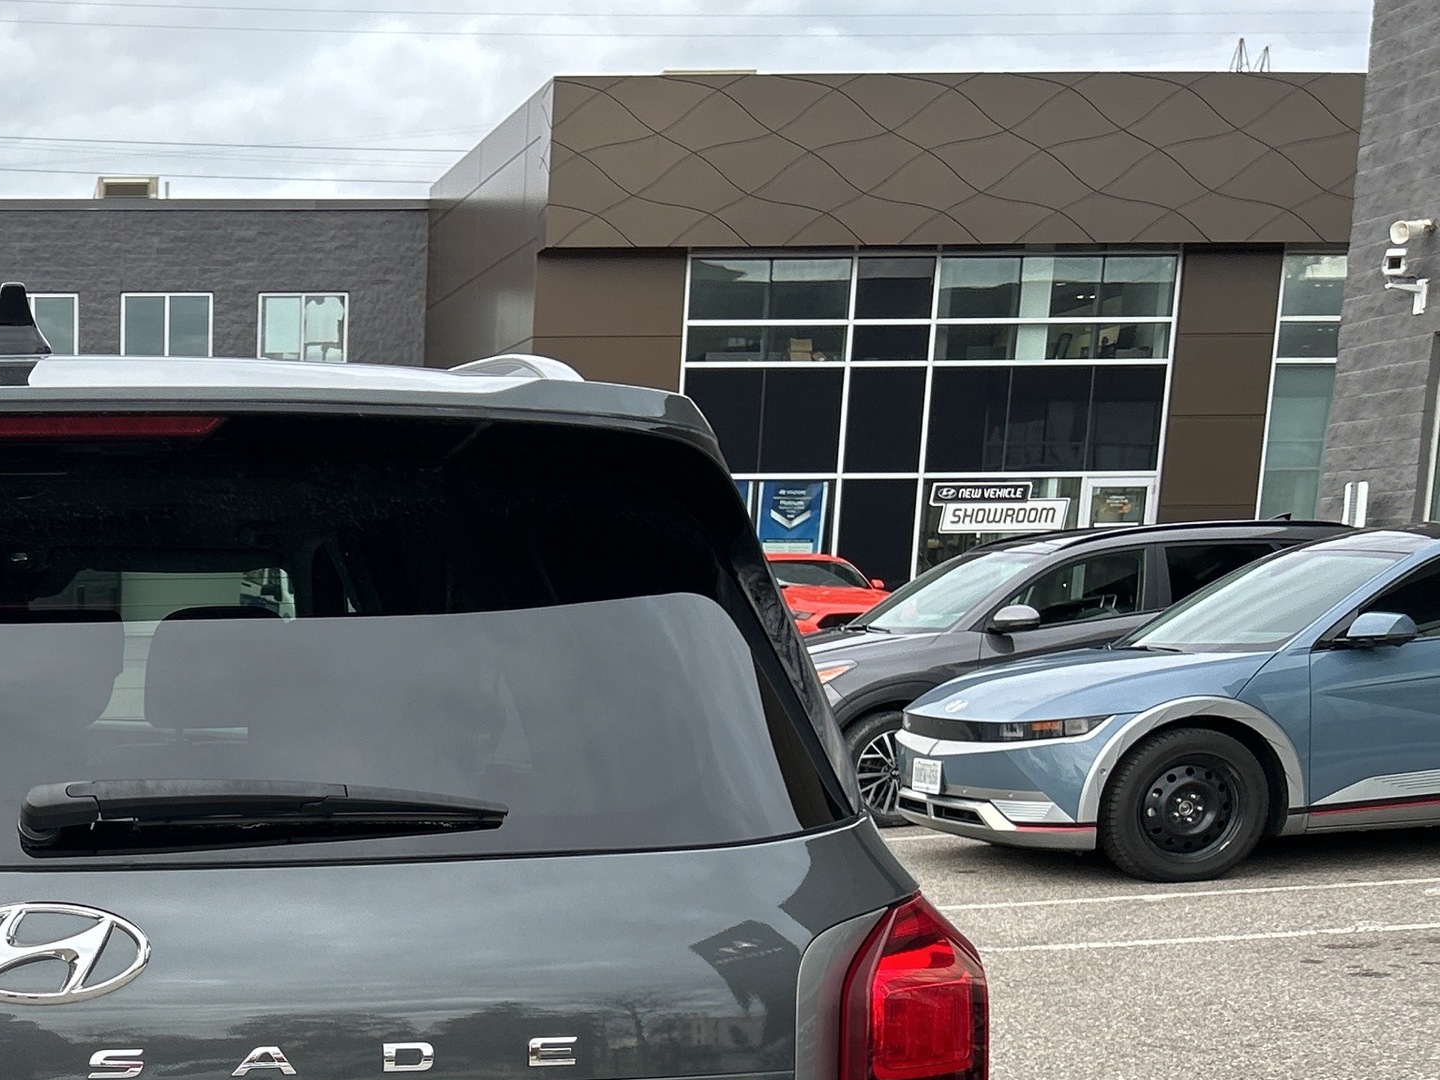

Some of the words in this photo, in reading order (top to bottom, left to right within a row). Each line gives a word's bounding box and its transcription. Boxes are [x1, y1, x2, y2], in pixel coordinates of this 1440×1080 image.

[958, 488, 981, 499] NEW
[984, 487, 1024, 499] VEHICLE
[950, 507, 1056, 524] SHOWROOM
